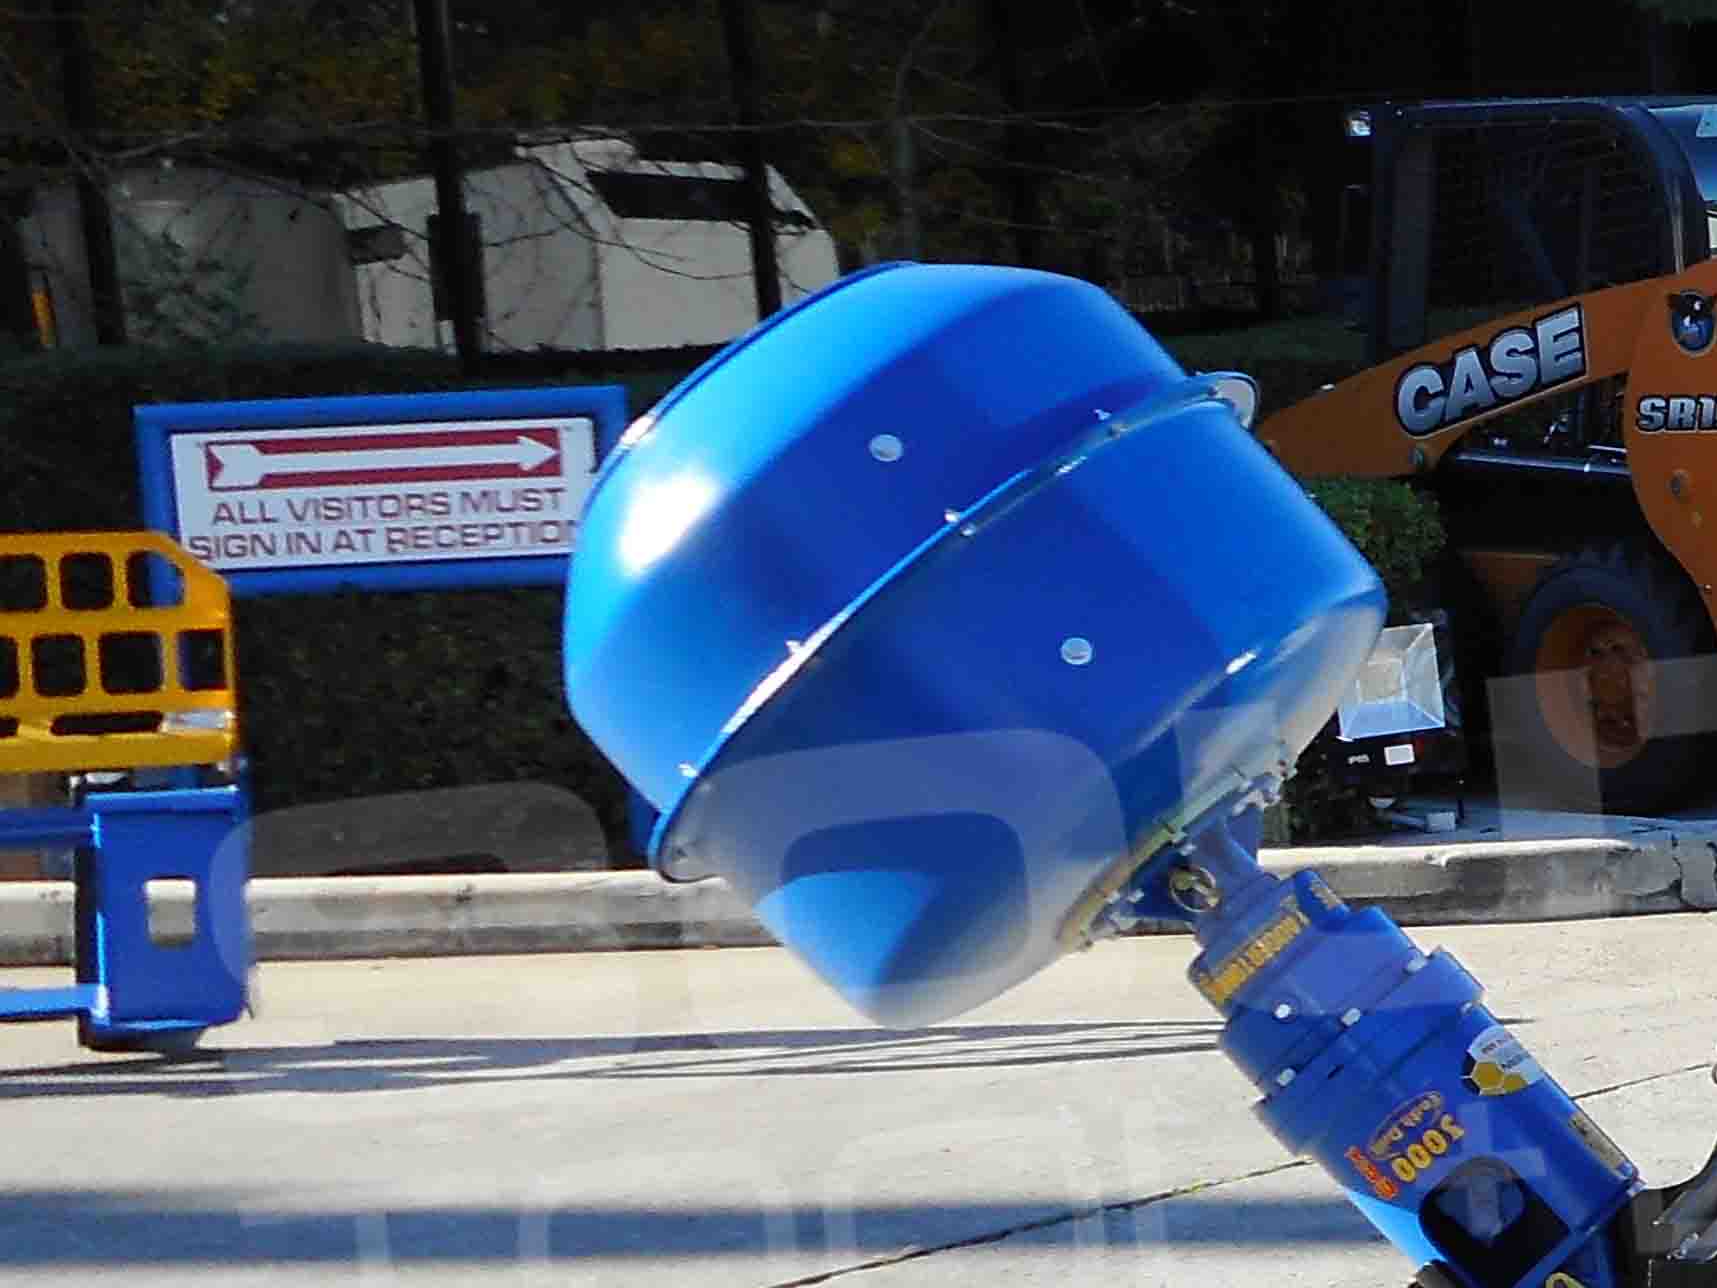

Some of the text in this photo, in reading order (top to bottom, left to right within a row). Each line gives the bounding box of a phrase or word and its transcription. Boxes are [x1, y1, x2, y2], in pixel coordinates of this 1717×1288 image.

[1398, 305, 1588, 436] CASE
[210, 486, 568, 525] ALL VISITORS MUST
[189, 531, 277, 562] SIGN
[286, 530, 322, 555] IN
[332, 527, 376, 554] AT
